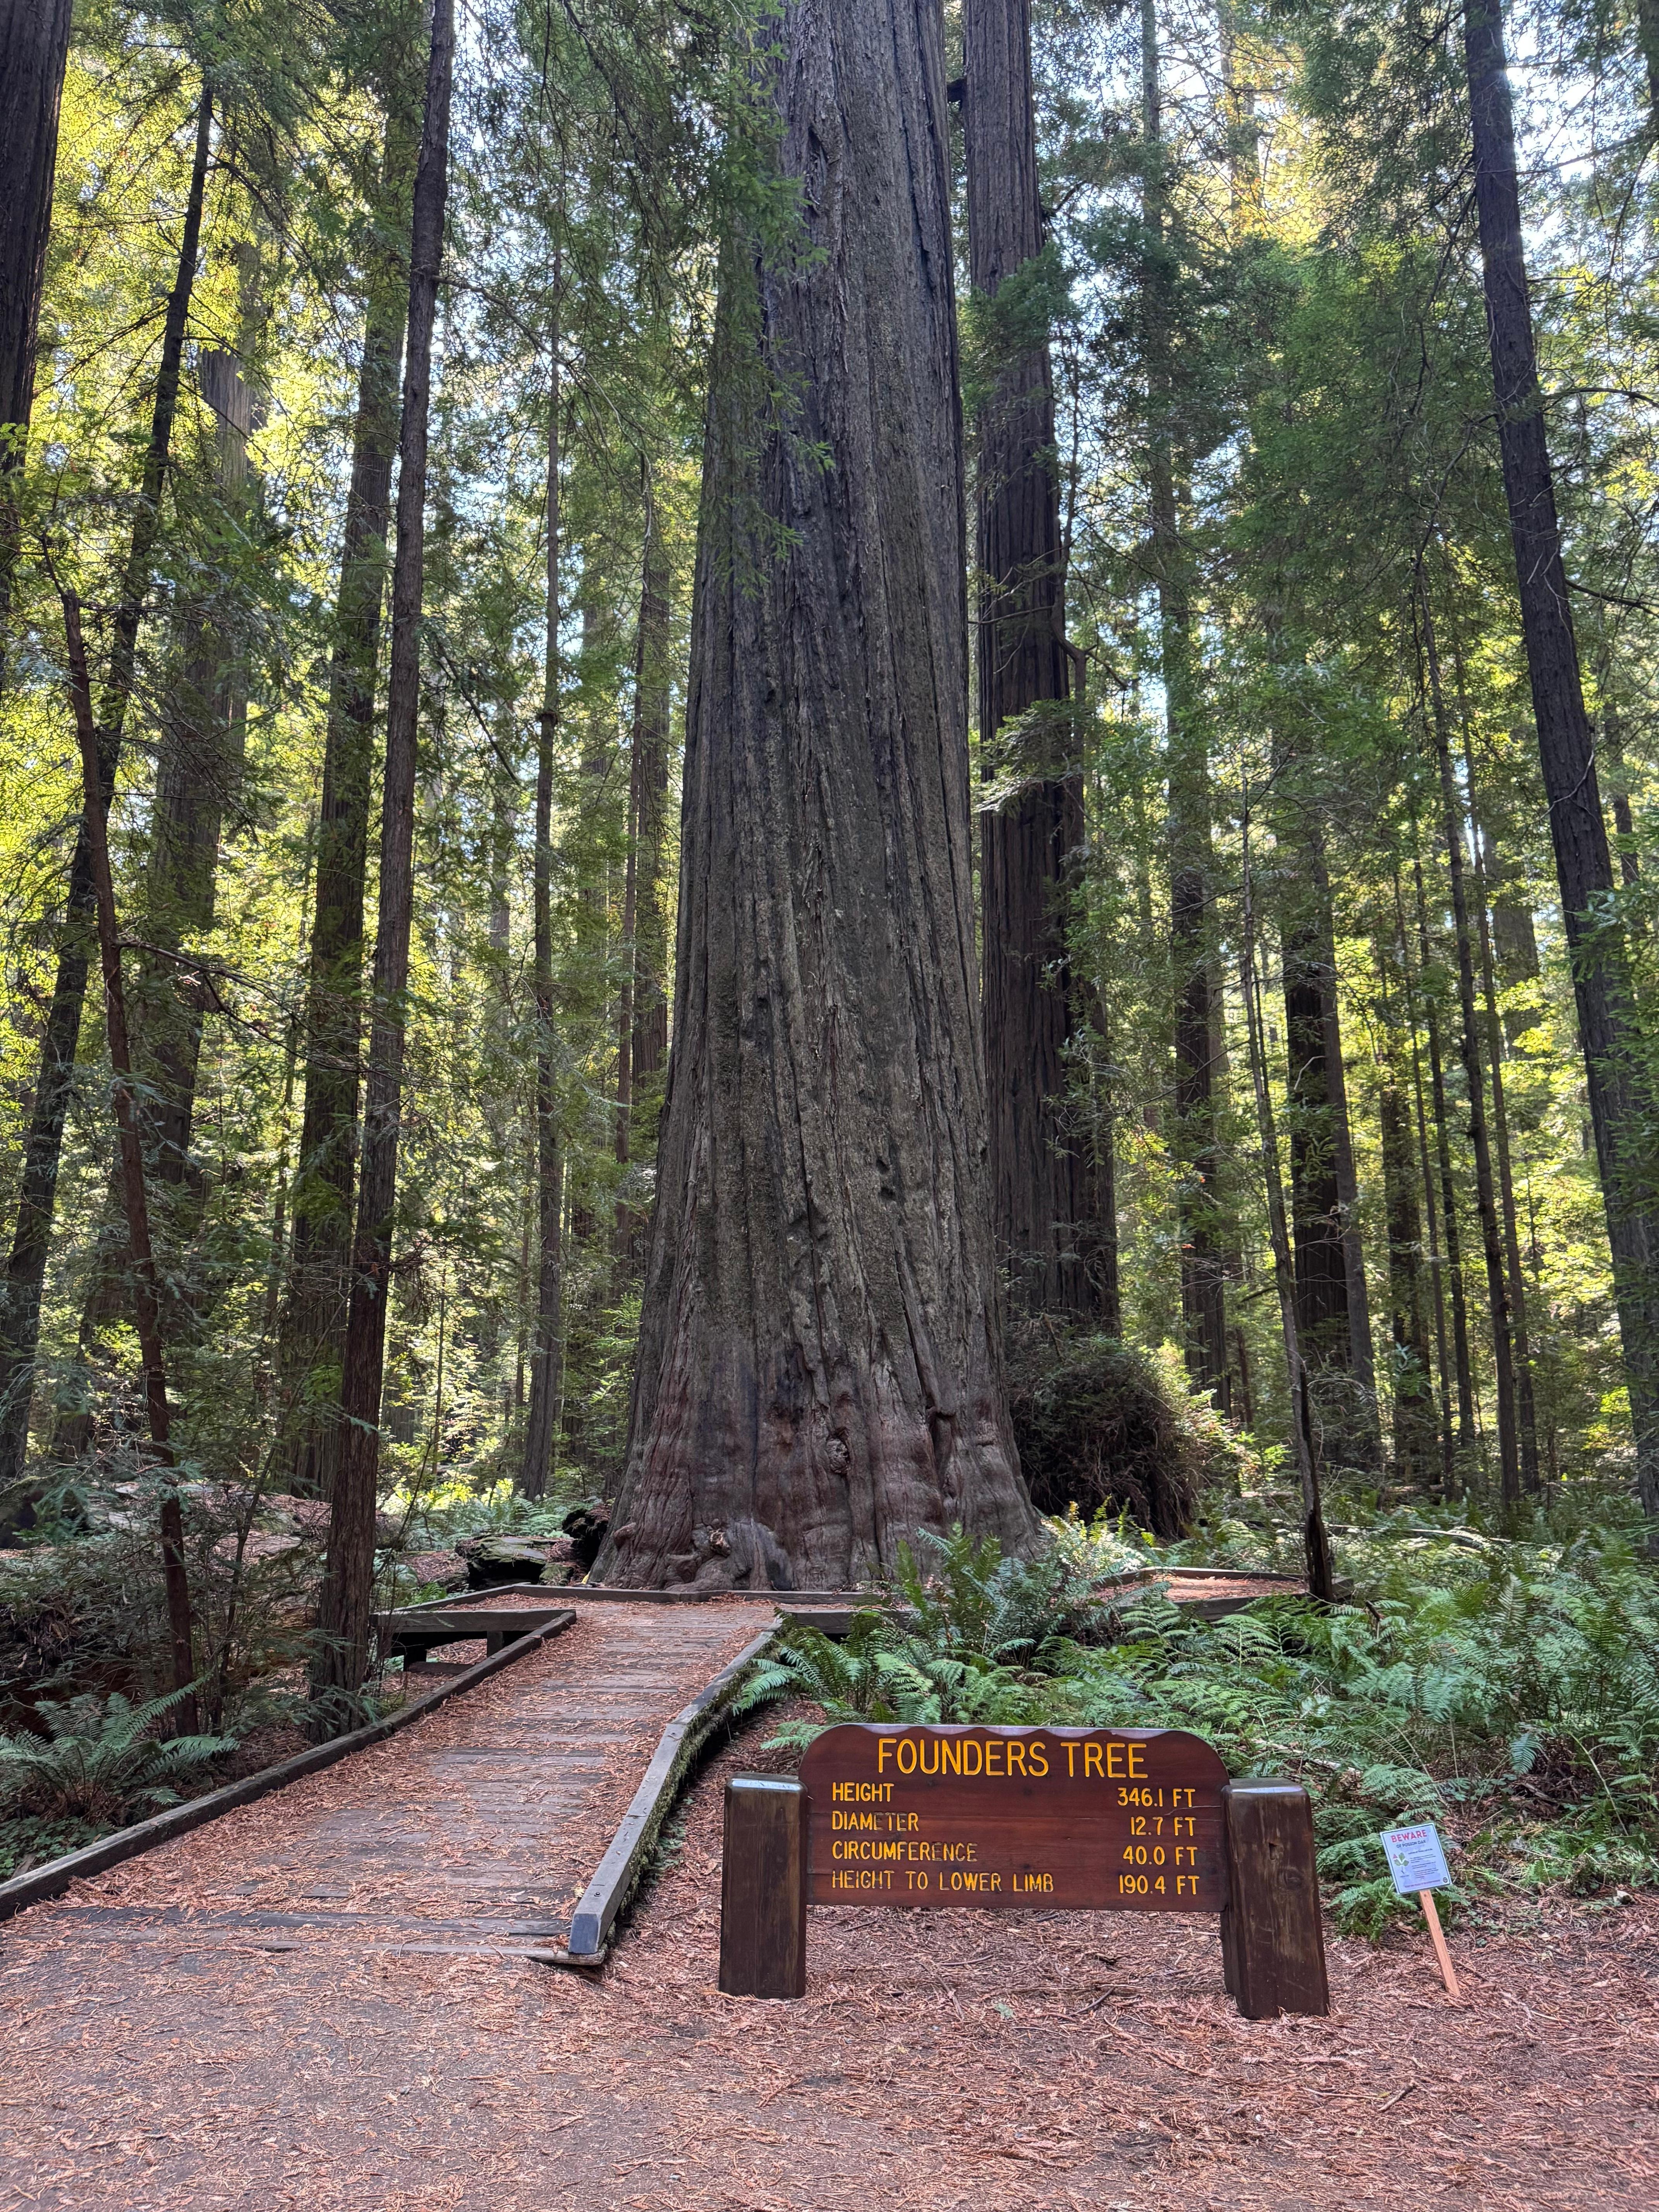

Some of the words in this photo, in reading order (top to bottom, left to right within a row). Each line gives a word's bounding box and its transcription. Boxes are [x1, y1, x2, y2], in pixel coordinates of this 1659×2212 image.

[878, 1738, 1049, 1777] FOUNDERS
[1060, 1741, 1149, 1779] TREE
[832, 1781, 894, 1803] HEIGHT
[1117, 1787, 1163, 1807] 346.1
[1172, 1788, 1196, 1808] FT
[831, 1810, 919, 1832] DIAMETER
[1130, 1816, 1163, 1836] 12.7
[1173, 1816, 1196, 1837] FT
[1391, 1830, 1427, 1843] BEWARE
[832, 1840, 978, 1862] CIRCUMFERENCE
[1122, 1845, 1166, 1866] 40.0
[1175, 1846, 1198, 1866] FT
[832, 1870, 893, 1889] HEIGHT
[905, 1870, 929, 1890] TO
[939, 1872, 1001, 1892] LOWER
[1013, 1873, 1054, 1893] LIMB
[1119, 1874, 1166, 1894] 190.4
[1176, 1875, 1200, 1895] FT
